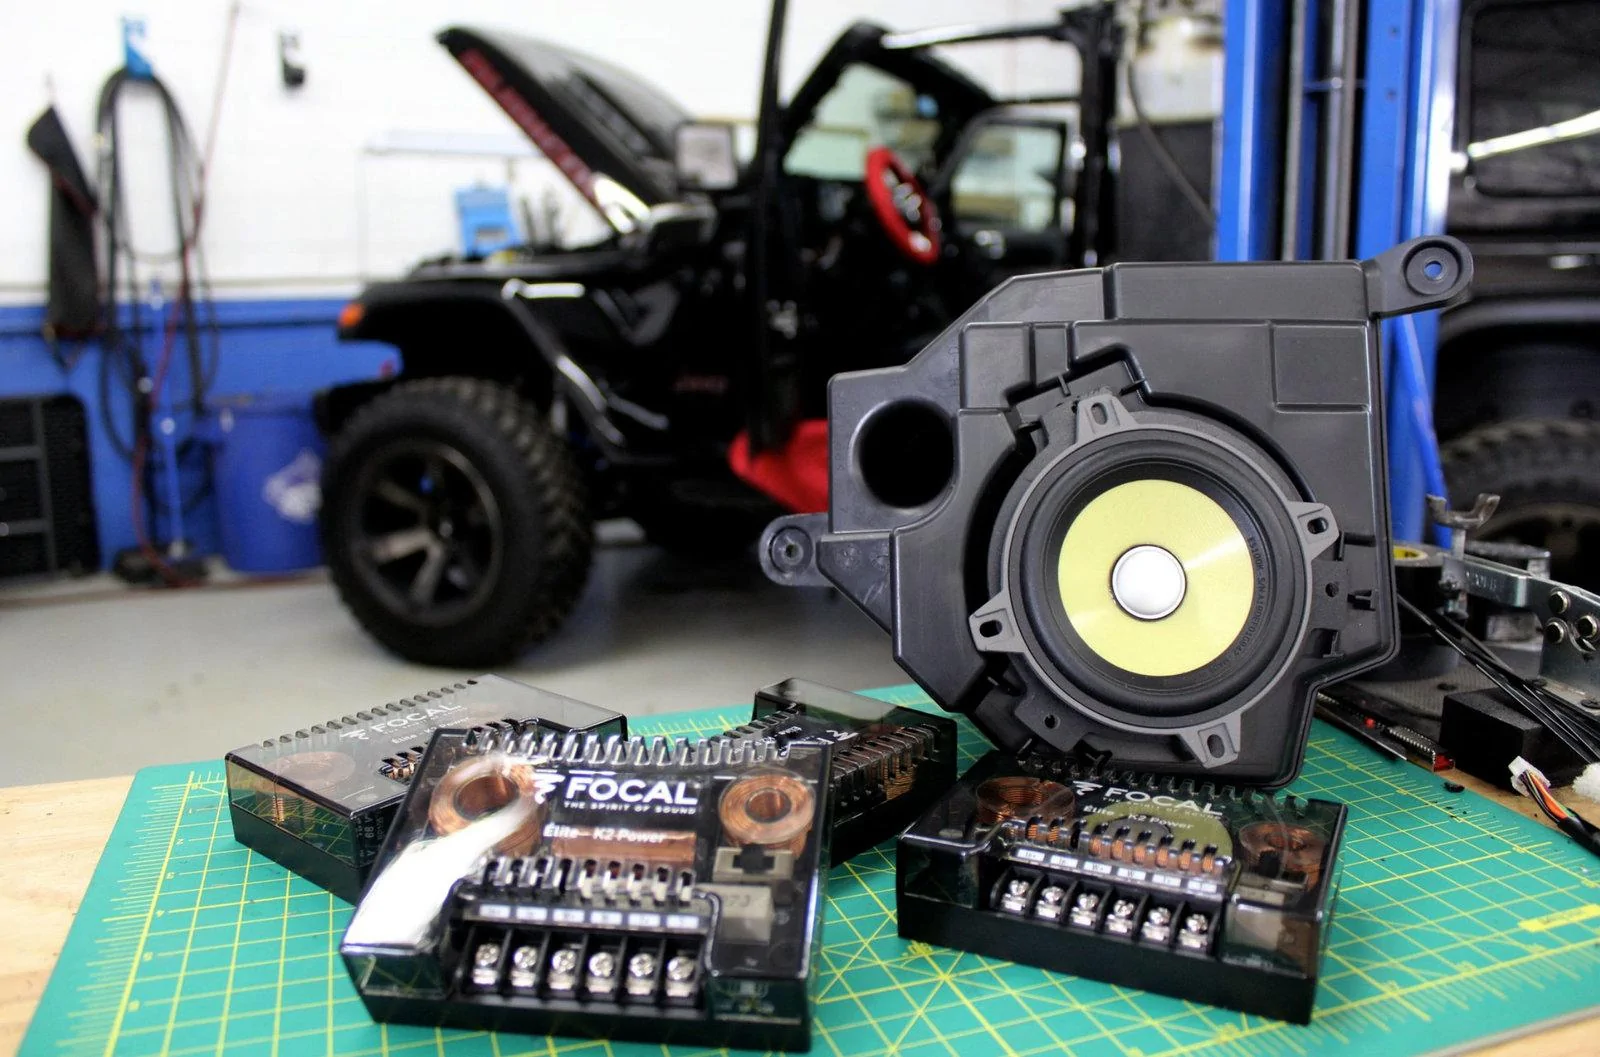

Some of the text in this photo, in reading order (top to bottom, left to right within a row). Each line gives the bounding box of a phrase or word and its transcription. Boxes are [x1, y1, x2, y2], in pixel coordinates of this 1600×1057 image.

[370, 704, 462, 732] FOCAL
[565, 776, 698, 806] FOCAL
[1104, 787, 1223, 816] FOCAL
[564, 801, 697, 815] THE SPIRIT OF SOUND
[1150, 817, 1194, 830] Power
